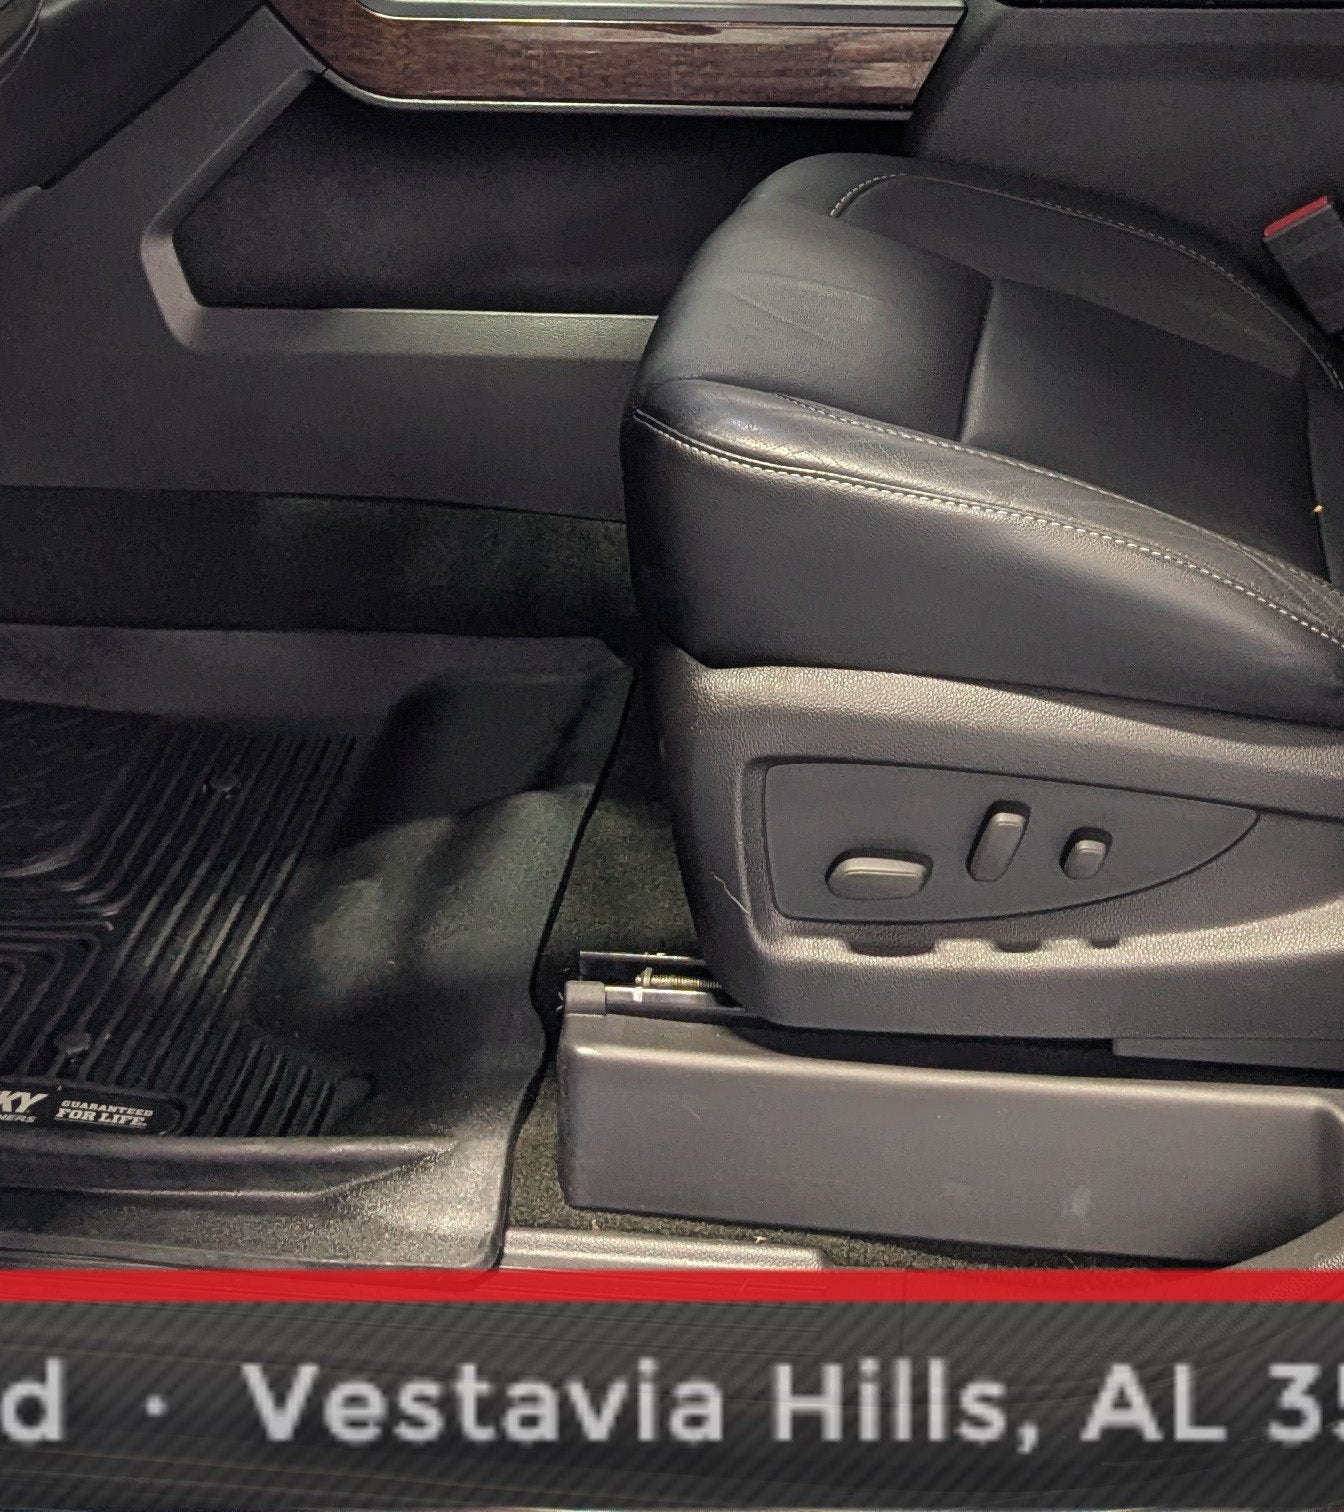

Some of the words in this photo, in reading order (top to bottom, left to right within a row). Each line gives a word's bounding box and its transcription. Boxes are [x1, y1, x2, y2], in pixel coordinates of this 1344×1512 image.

[55, 1107, 97, 1122] FOR
[97, 1112, 148, 1127] LIFE
[60, 1099, 154, 1117] GUARANTEED
